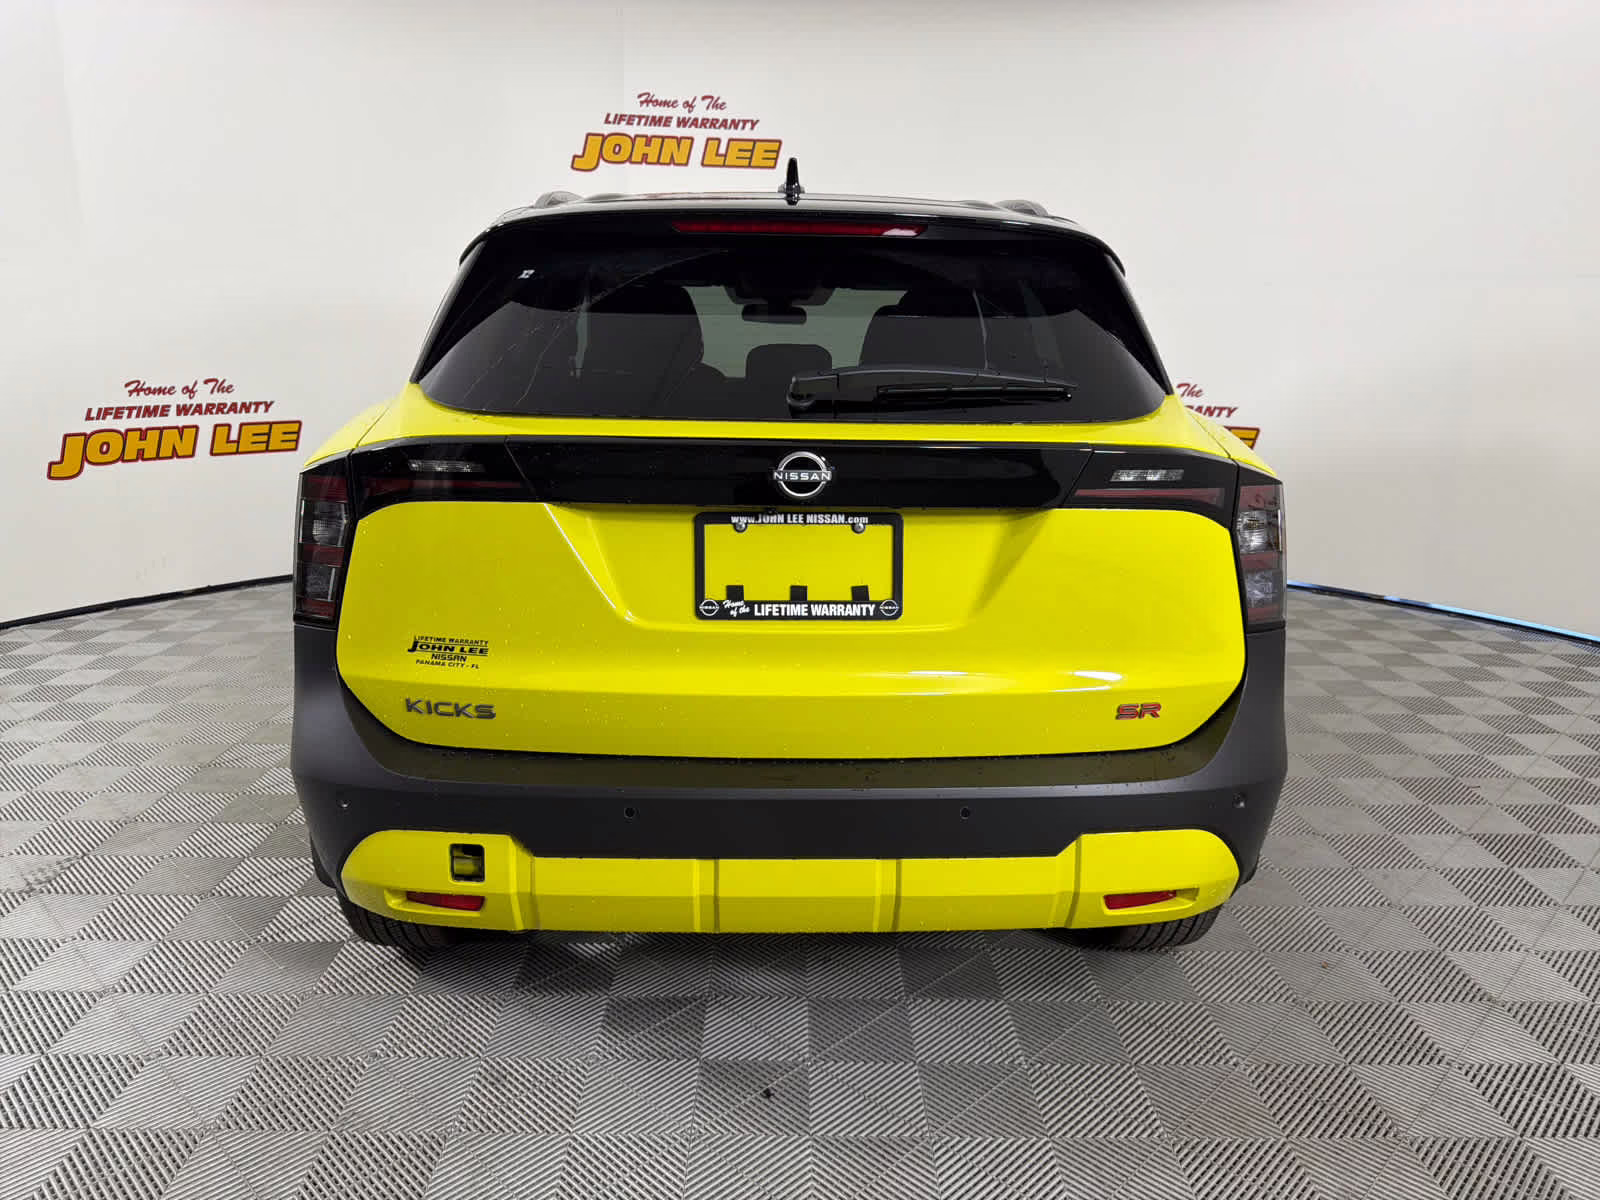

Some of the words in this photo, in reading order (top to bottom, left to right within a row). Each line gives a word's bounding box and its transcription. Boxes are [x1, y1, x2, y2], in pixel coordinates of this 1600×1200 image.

[637, 92, 679, 109] Home
[682, 96, 696, 113] of
[700, 95, 727, 111] The
[604, 113, 673, 127] LIFETIME
[676, 116, 759, 130] WARRANTY
[571, 133, 694, 172] JOHN
[701, 137, 783, 169] LEE
[124, 379, 177, 397] Home
[181, 381, 198, 399] of
[203, 378, 235, 395] The
[1176, 383, 1204, 398] The
[85, 404, 171, 421] LIFETIME
[175, 401, 275, 417] WARRANTY
[47, 425, 199, 480] JOHN
[209, 420, 302, 456] LEE
[773, 471, 832, 481] NISSAN
[787, 514, 804, 524] LEE
[806, 514, 869, 524] NISSAN.com
[723, 600, 745, 608] Home
[754, 603, 809, 616] LIFETIME
[810, 603, 876, 616] WARRANTY
[730, 608, 738, 617] of
[407, 641, 455, 653] JOHN
[459, 647, 489, 655] LEE
[415, 659, 446, 667] PANAMA
[431, 654, 467, 662] NISSAN
[405, 697, 496, 719] KICKS
[1115, 703, 1161, 720] SR
